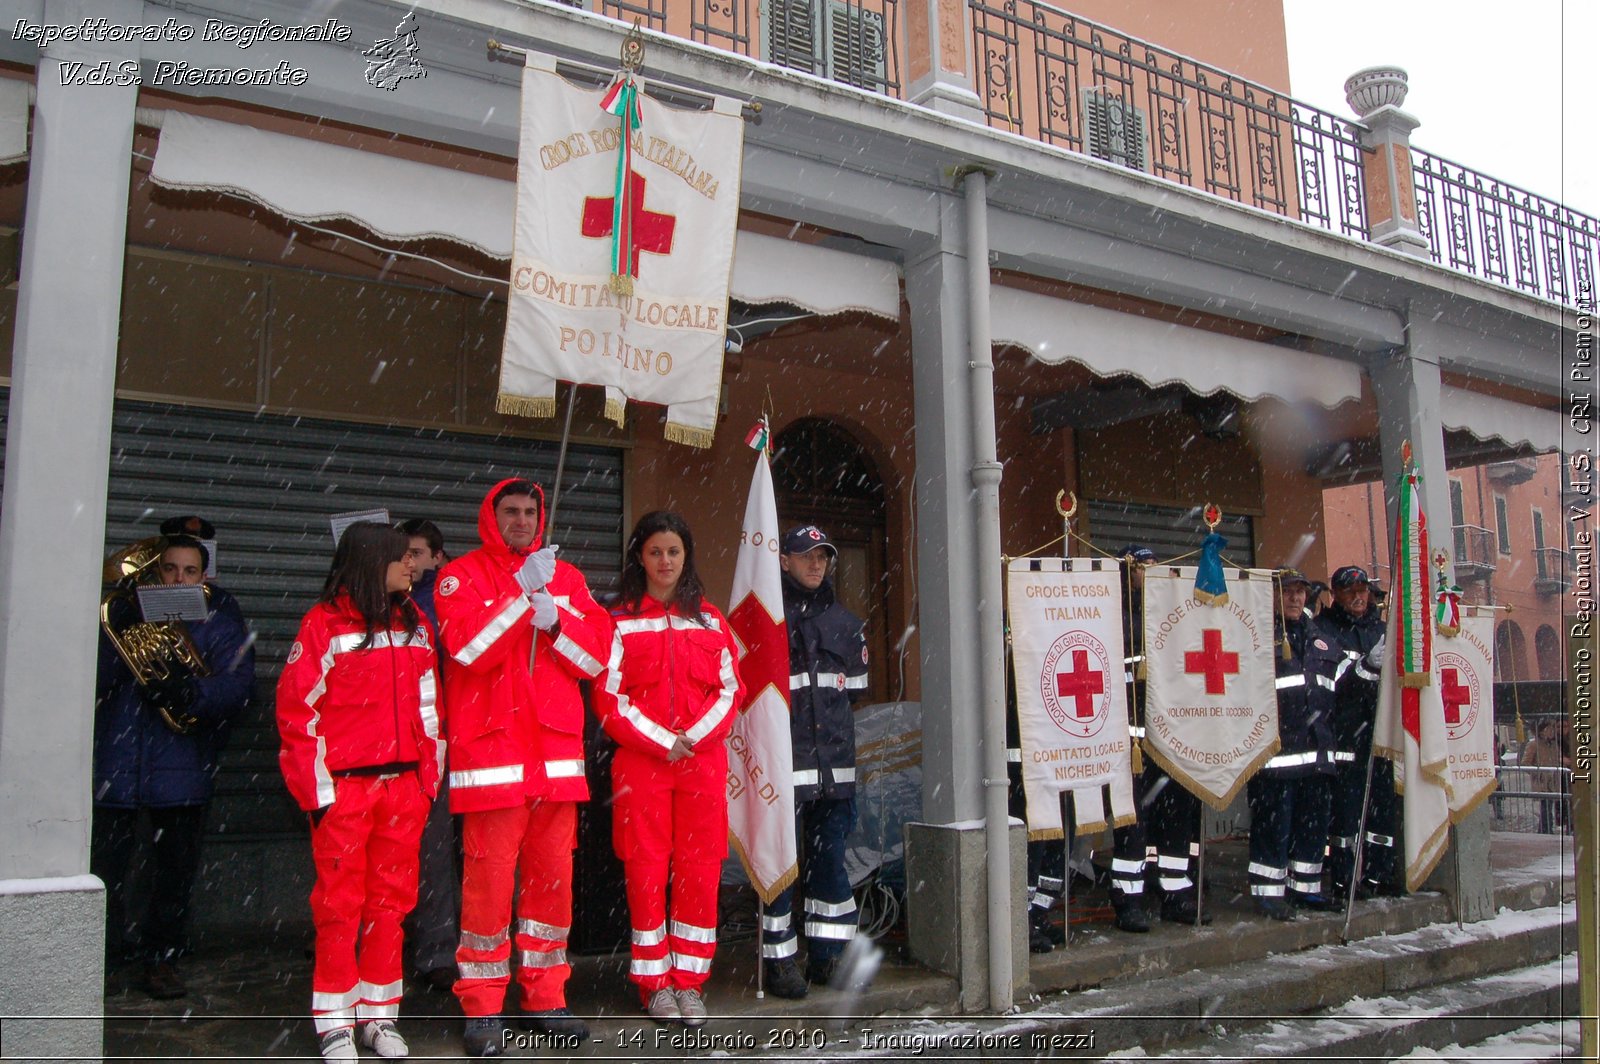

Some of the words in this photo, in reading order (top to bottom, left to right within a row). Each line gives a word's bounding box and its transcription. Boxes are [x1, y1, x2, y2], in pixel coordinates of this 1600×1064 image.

[540, 132, 590, 171] CROCE
[645, 136, 720, 200] ITALIANA
[635, 298, 719, 330] LOCALE
[1408, 520, 1421, 575] ITALIANA
[1025, 585, 1069, 598] CROCE
[1071, 584, 1110, 597] ROSSA
[1410, 578, 1423, 619] ROSSA
[1044, 606, 1101, 620] ITALIANA
[1228, 601, 1260, 652] ITALIANA
[1062, 633, 1094, 647] GINEVRA
[1154, 606, 1186, 650] CROCE
[1054, 642, 1064, 654] DI
[1095, 643, 1104, 655] 22
[1411, 623, 1424, 668] CROCE
[1461, 629, 1492, 665] ITALIANA
[1463, 664, 1471, 676] 22
[1043, 651, 1066, 724] CONVENZIONE
[1167, 706, 1207, 718] VOLONTARI
[1033, 746, 1092, 763] COMITATO
[1094, 741, 1125, 757] LOCALE
[1153, 715, 1170, 739] SAN
[1168, 736, 1233, 765] FRANCESCO
[1242, 713, 1270, 750] CAMPO
[1055, 760, 1111, 780] NICHELINO
[759, 782, 779, 806] DI
